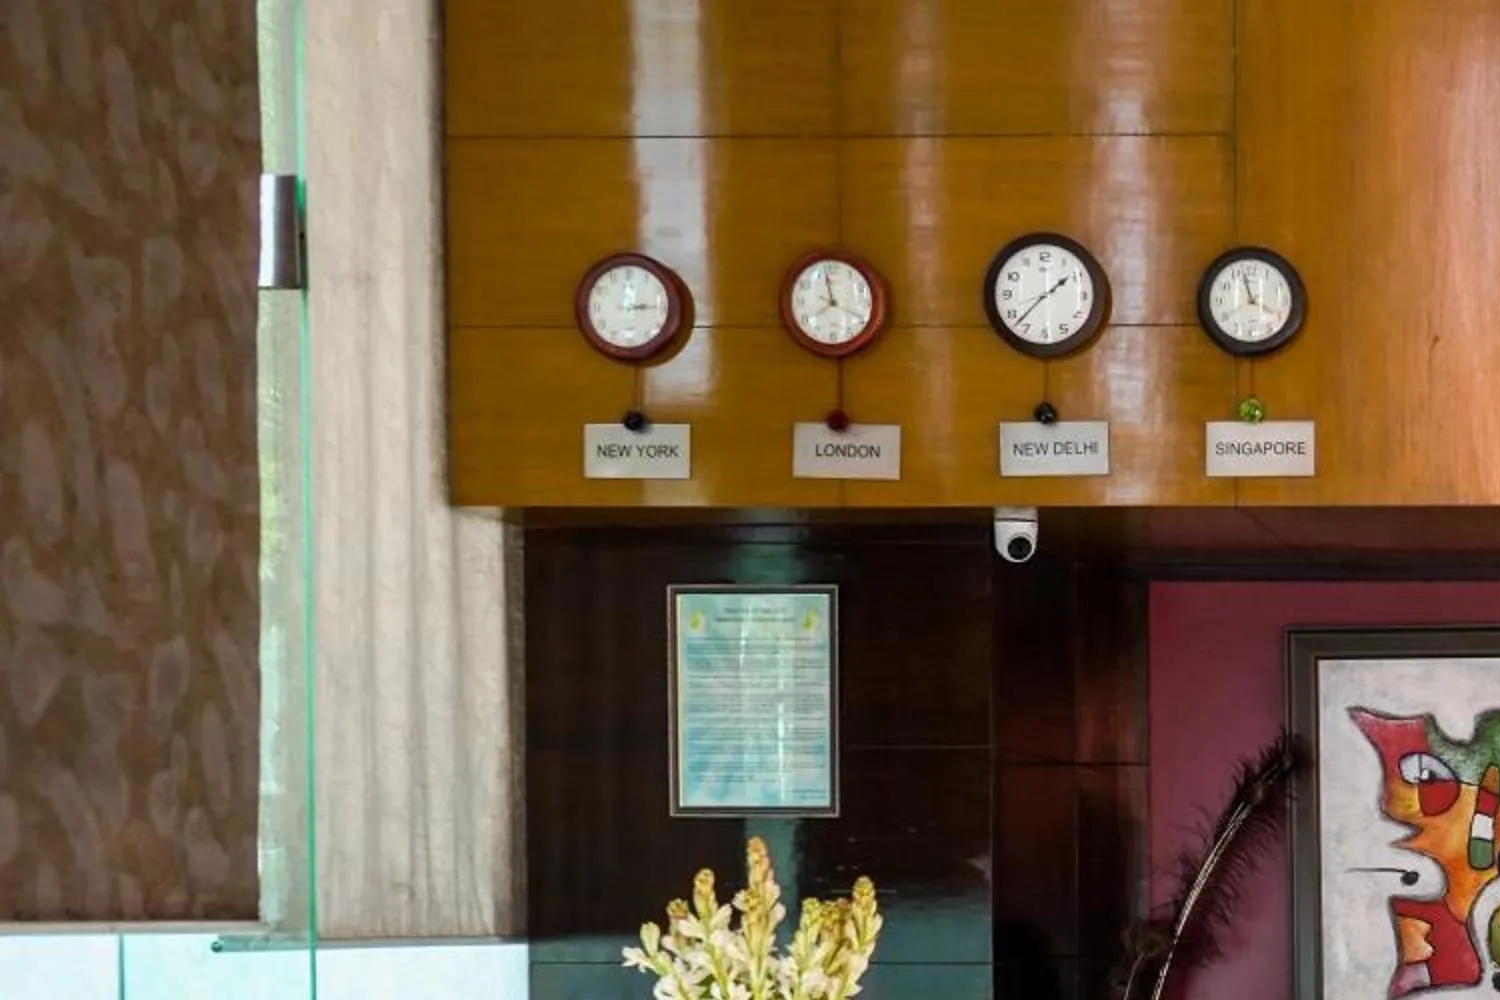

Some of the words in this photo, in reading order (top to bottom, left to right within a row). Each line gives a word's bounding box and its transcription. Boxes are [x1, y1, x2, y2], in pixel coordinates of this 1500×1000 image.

[597, 444, 631, 457] NEW
[636, 444, 679, 457] YORK
[815, 444, 880, 458] LONDON
[1012, 443, 1049, 457] NEW
[1053, 441, 1098, 455] DELHI
[1215, 441, 1306, 455] SINGAPORE
